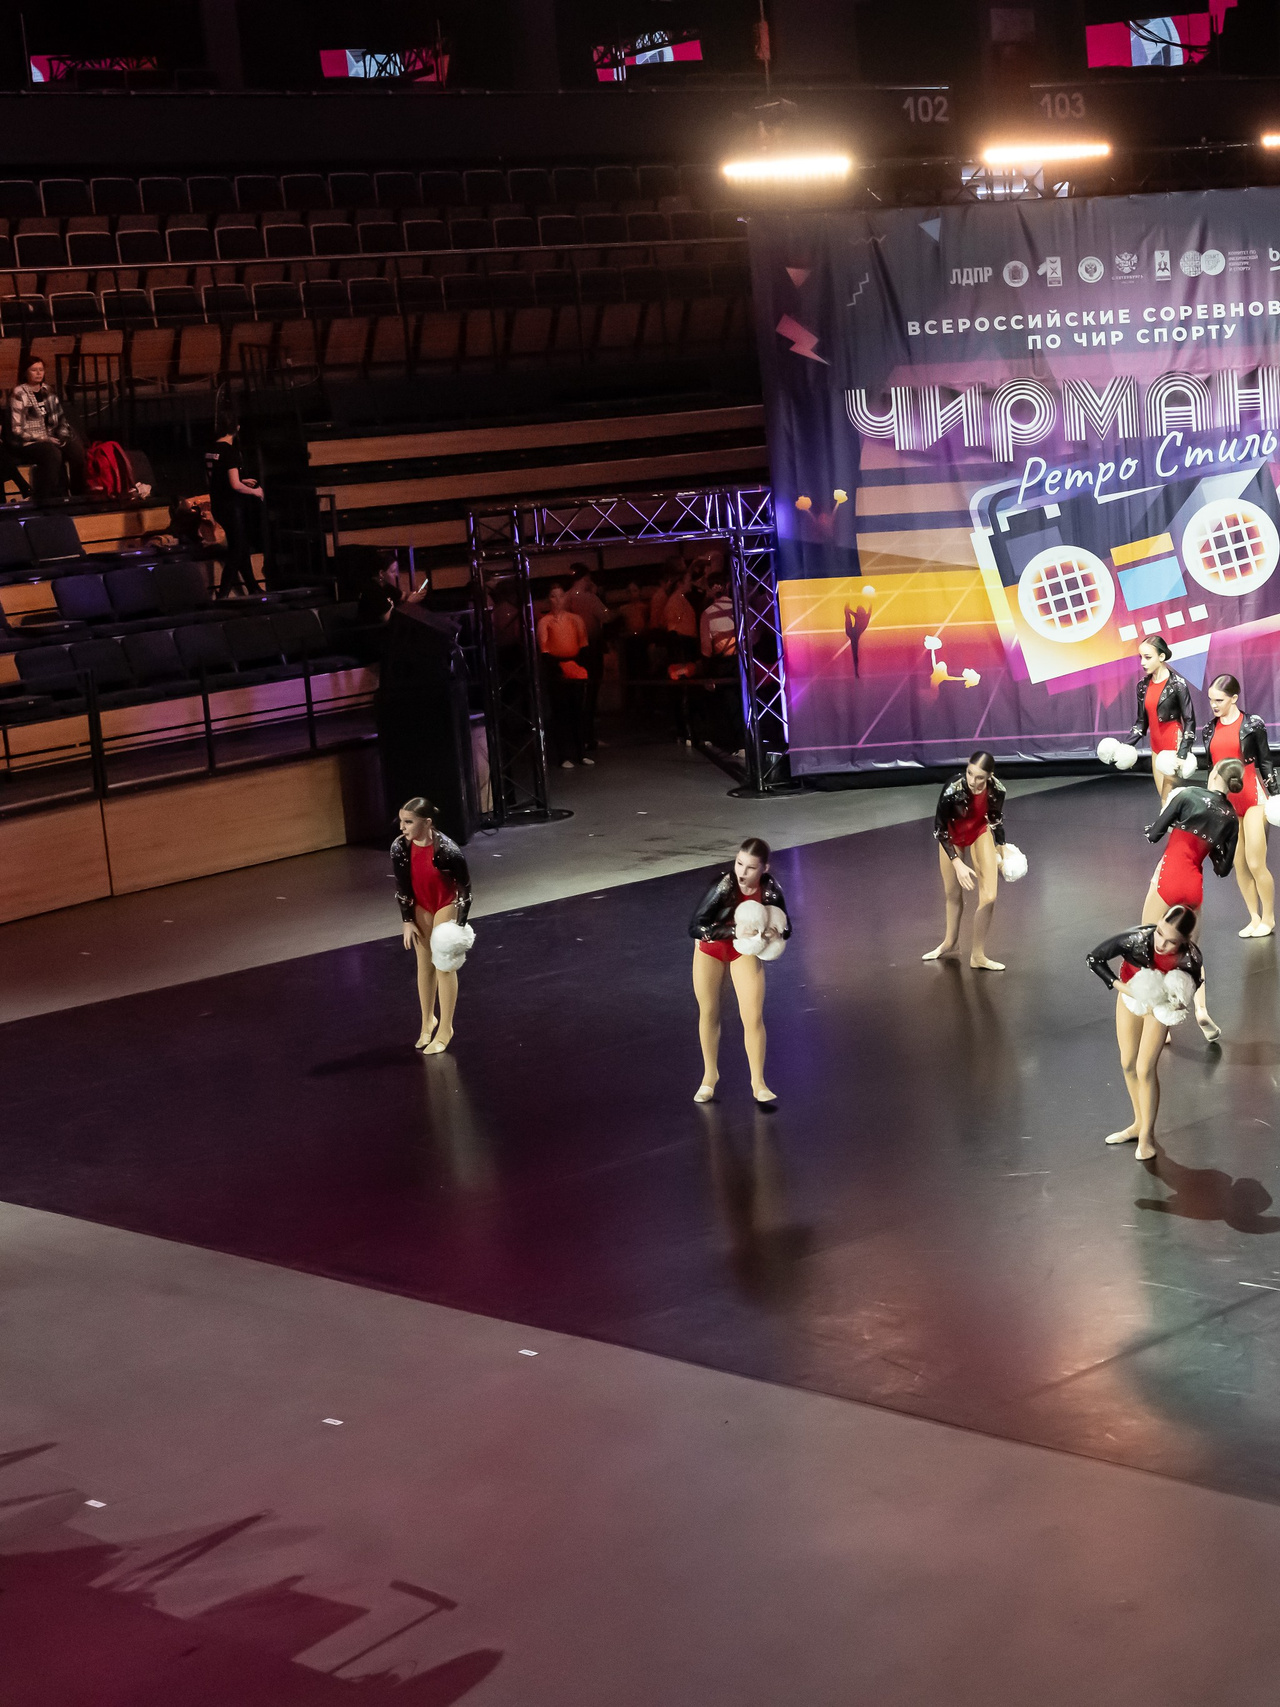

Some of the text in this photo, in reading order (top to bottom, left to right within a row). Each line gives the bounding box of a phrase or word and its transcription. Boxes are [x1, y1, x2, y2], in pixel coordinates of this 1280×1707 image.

[903, 96, 949, 122] 102
[1040, 92, 1086, 119] 103
[950, 266, 993, 287] ЛДПР
[907, 308, 1131, 336] ВСЕРОССИЙСКИЕ
[1028, 323, 1238, 350] ПО ЧИР СПОРТУ
[1018, 430, 1278, 505] Ретро Стиль
